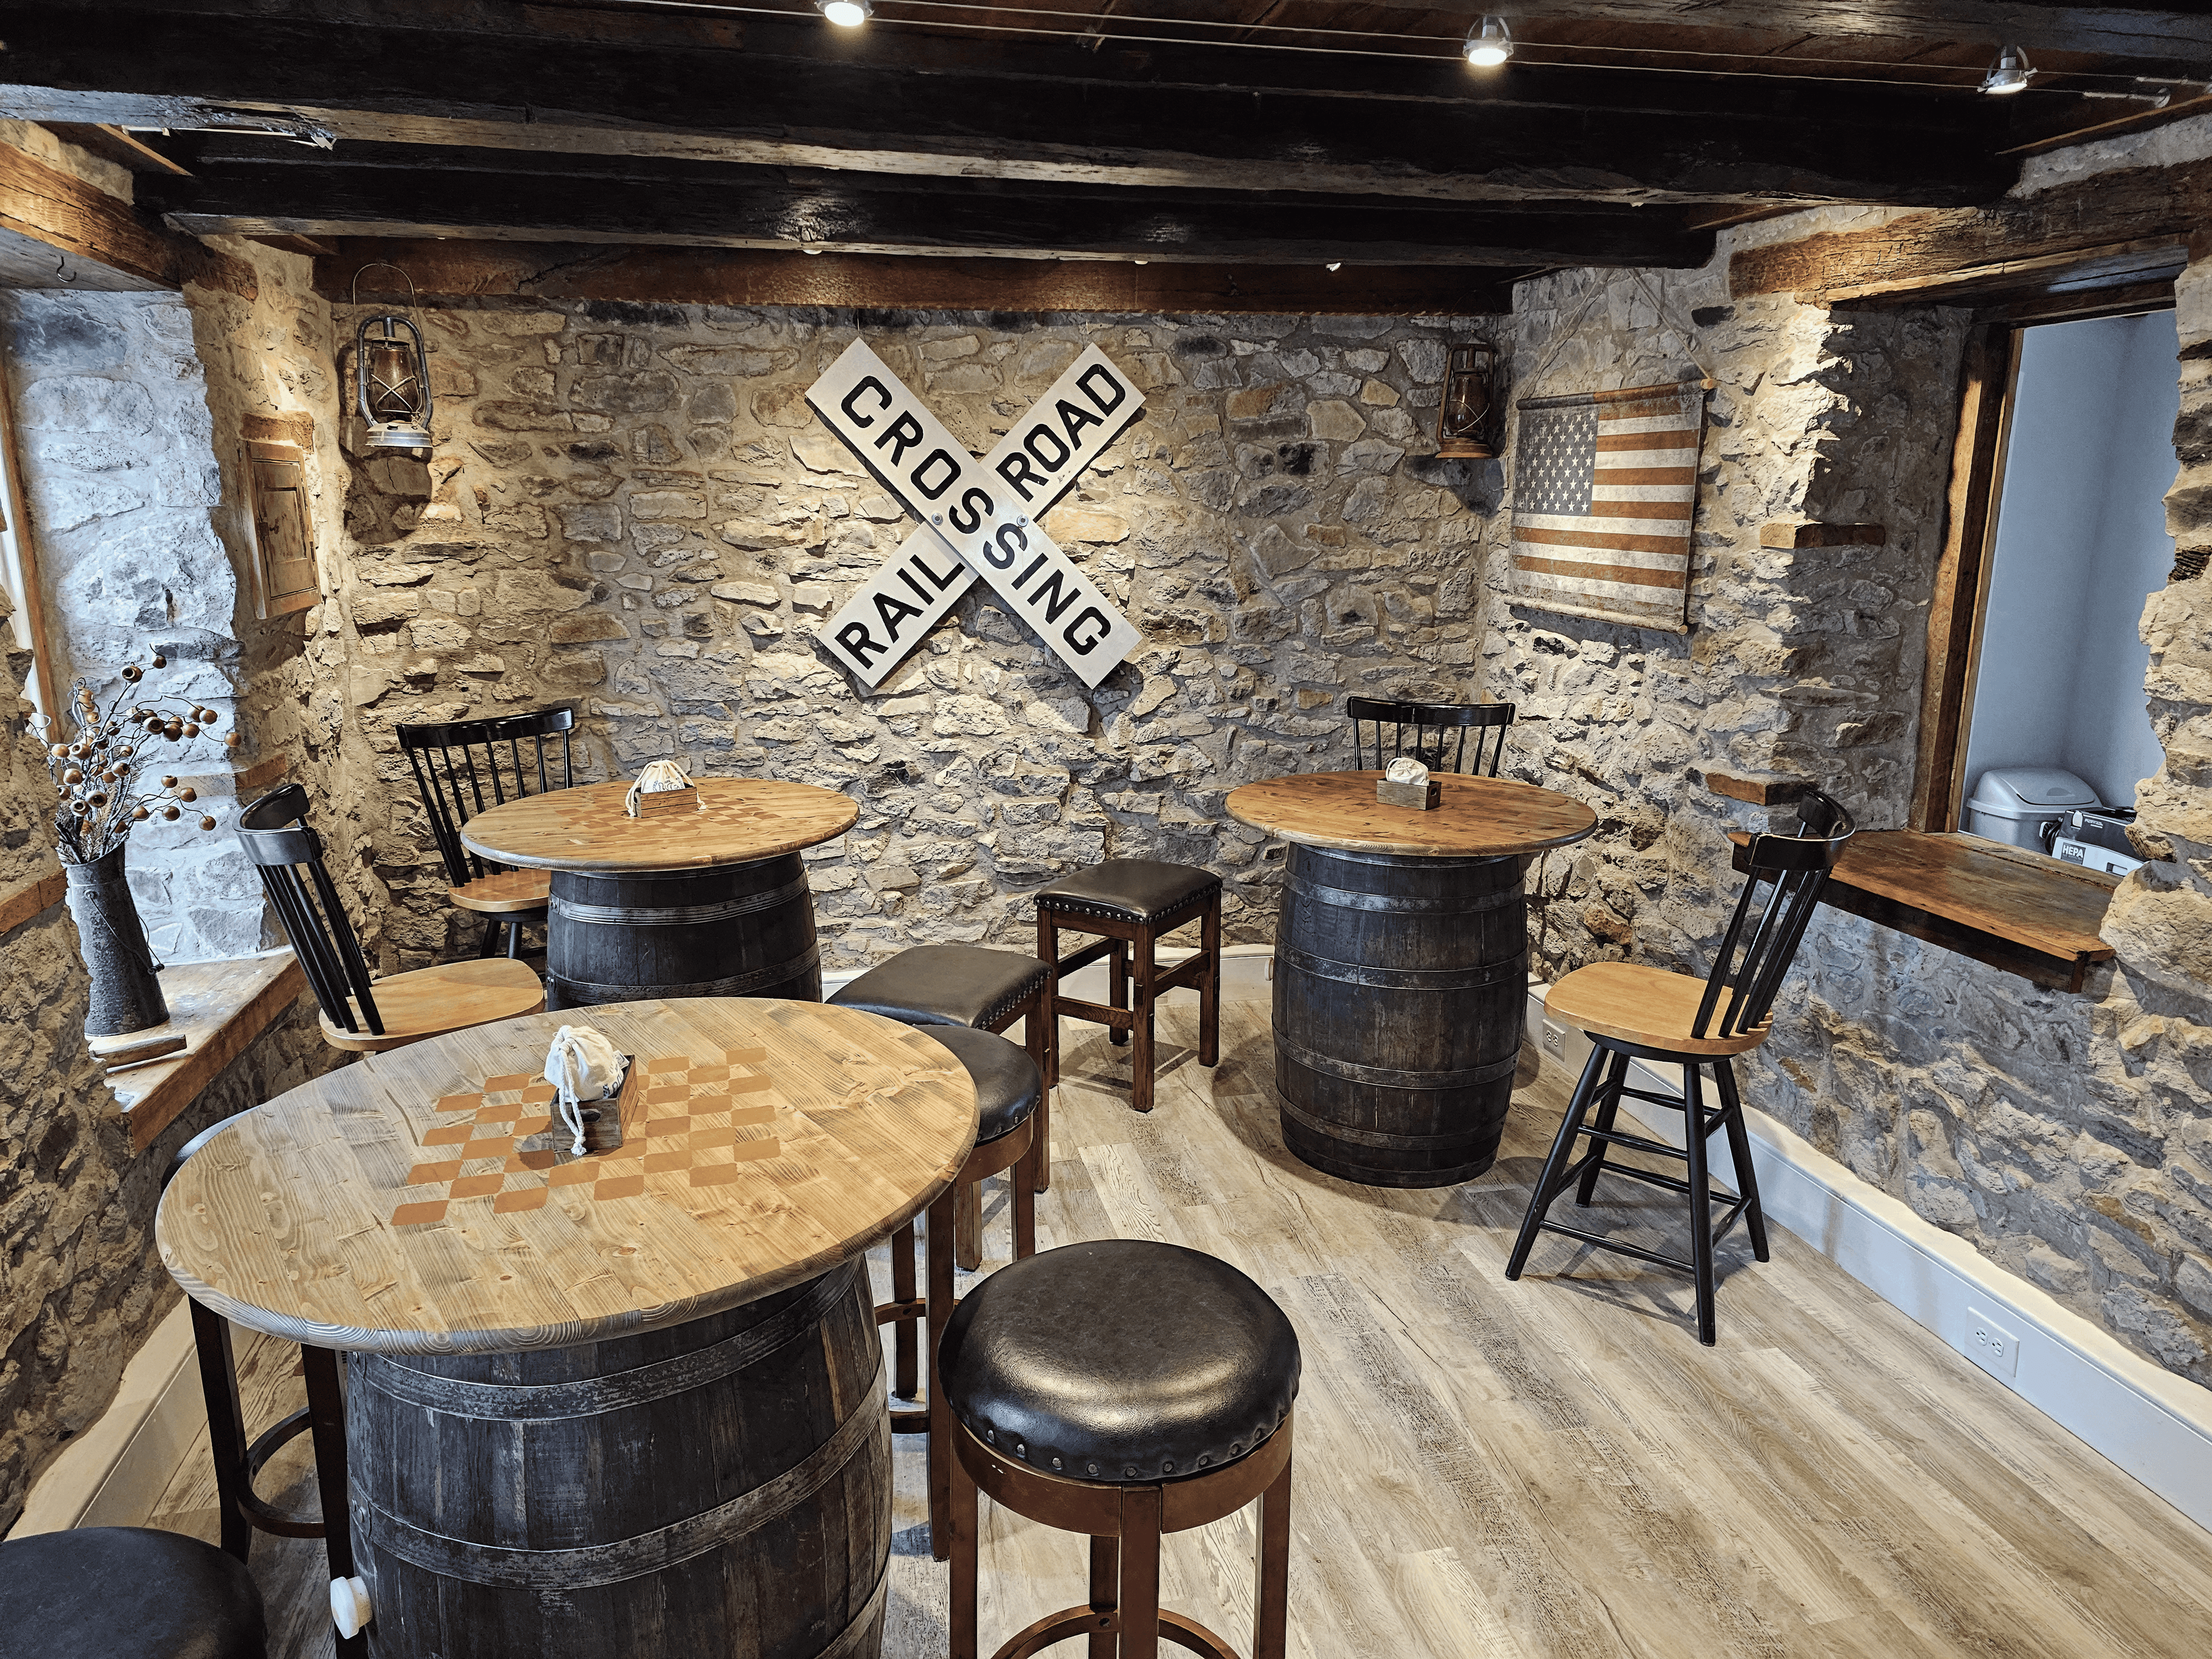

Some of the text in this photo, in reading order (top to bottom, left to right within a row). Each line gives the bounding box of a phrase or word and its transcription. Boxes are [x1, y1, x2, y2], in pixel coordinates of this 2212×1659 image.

[834, 363, 1126, 670] RAIL ROAD
[840, 375, 1112, 656] CROSSING
[2062, 844, 2084, 858] HEPA
